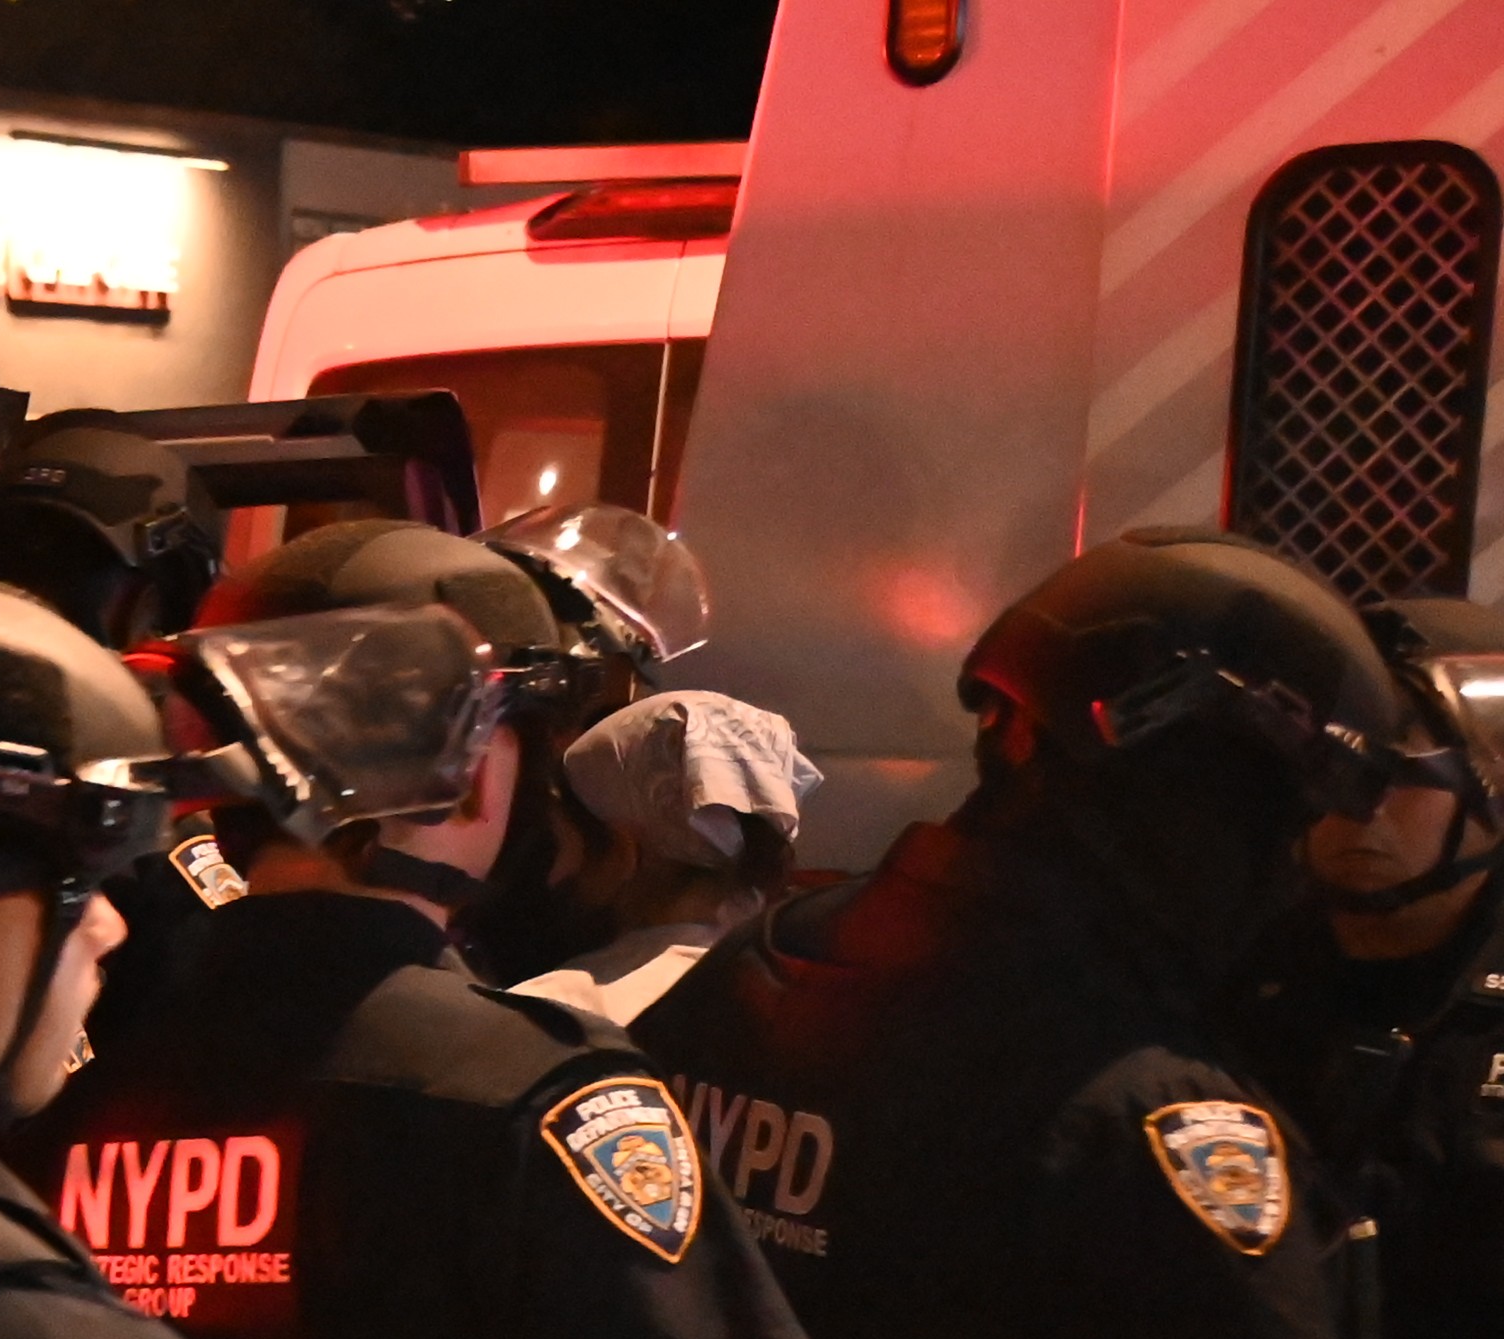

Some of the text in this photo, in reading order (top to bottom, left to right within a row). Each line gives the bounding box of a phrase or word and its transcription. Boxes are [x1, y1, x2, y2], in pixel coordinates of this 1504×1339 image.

[575, 1089, 643, 1122] POLICE
[59, 1135, 281, 1250] NYPD
[90, 1252, 291, 1285] TEGIC RESPONSE
